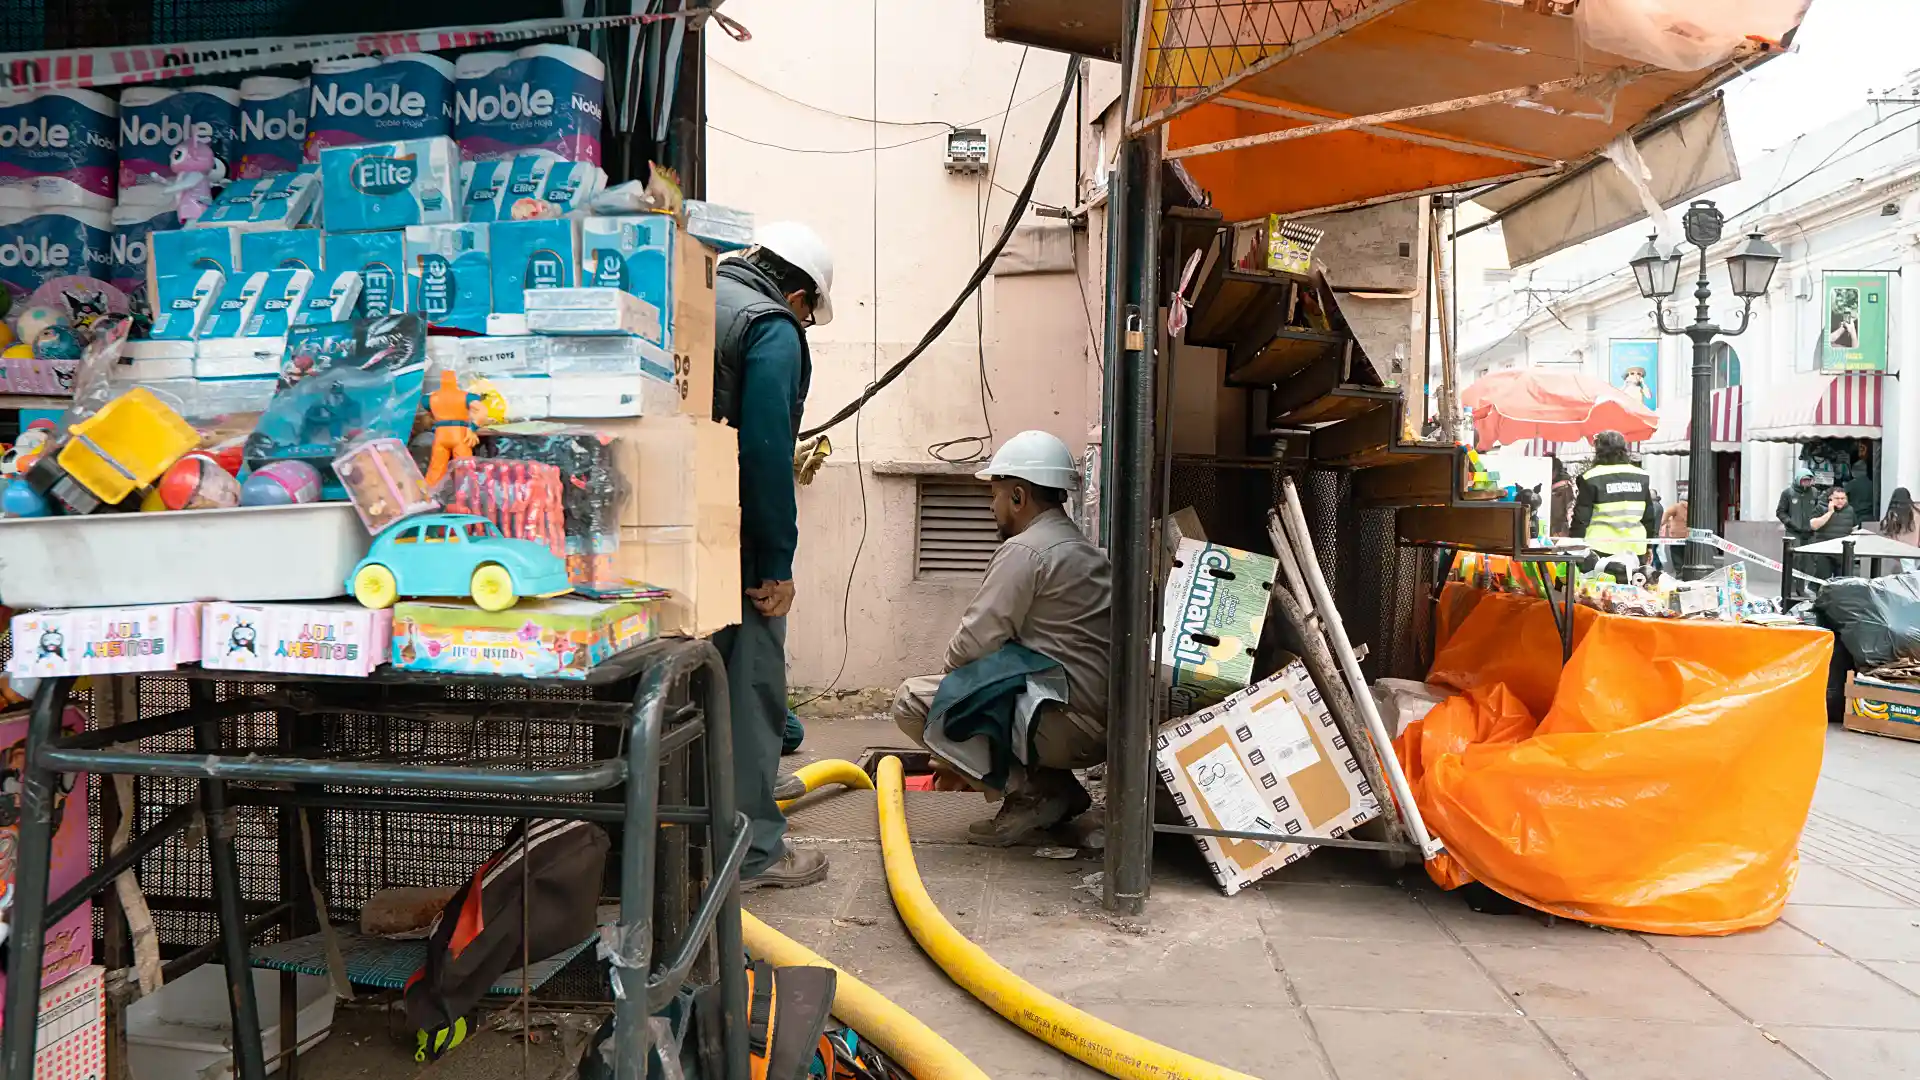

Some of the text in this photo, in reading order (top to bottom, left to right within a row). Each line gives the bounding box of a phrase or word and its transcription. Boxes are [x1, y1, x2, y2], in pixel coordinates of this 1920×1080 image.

[310, 82, 426, 118] Noble
[455, 82, 554, 126] Noble
[571, 94, 602, 120] Noble
[119, 114, 212, 147] Noble
[586, 145, 593, 156] 4
[360, 161, 412, 188] Elite
[513, 182, 536, 194] Elite
[373, 203, 381, 213] 6
[424, 260, 448, 314] Elite
[495, 351, 515, 361] TOYS
[1176, 550, 1230, 663] Carnaval
[105, 622, 142, 640] TOY
[298, 623, 337, 642] TOY
[82, 637, 165, 658] SQUISHY
[274, 639, 359, 661] SQUISHY
